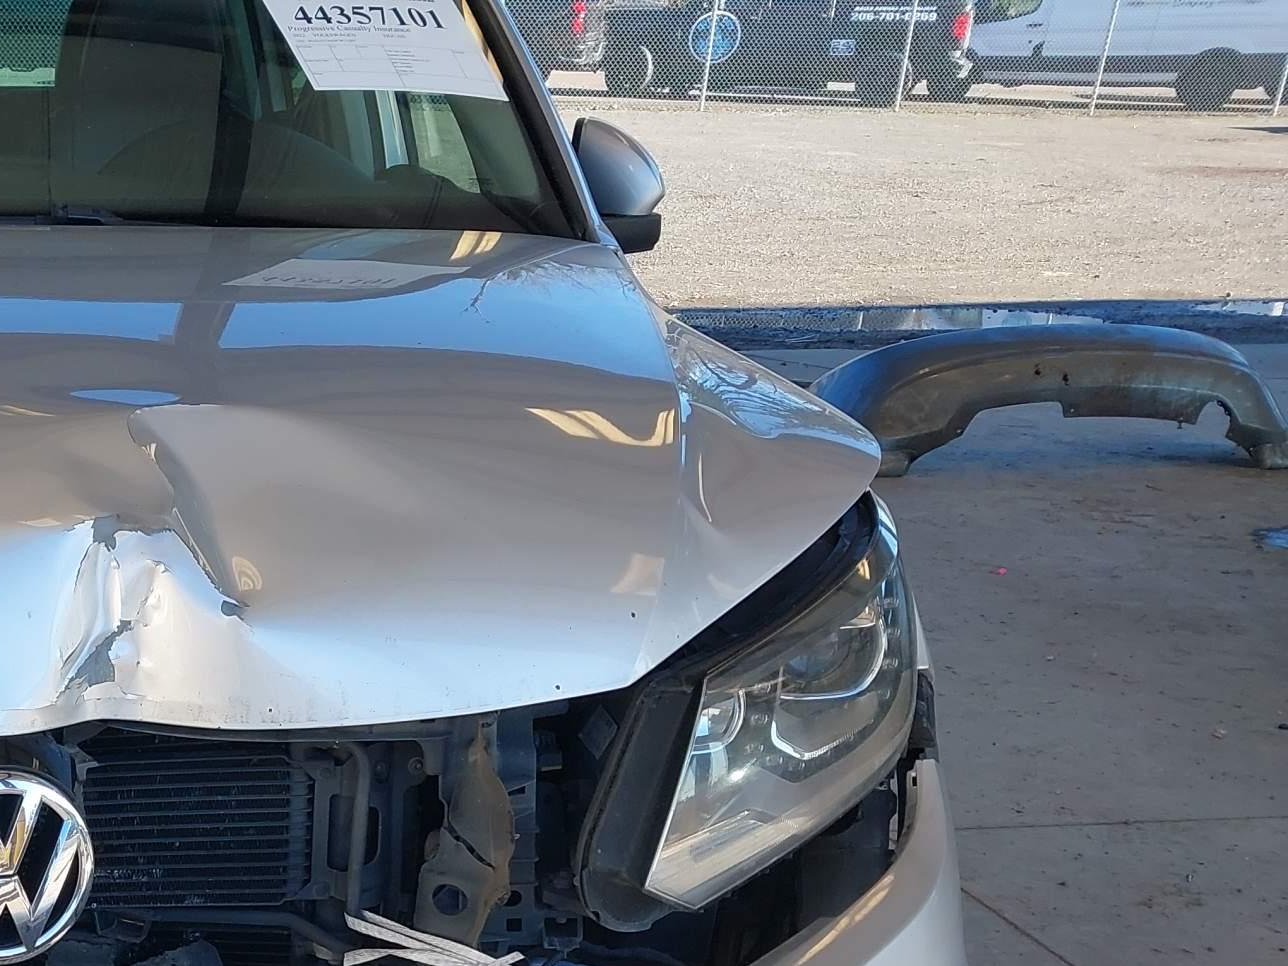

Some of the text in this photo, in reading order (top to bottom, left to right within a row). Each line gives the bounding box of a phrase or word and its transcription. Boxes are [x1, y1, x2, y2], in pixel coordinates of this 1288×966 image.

[294, 5, 447, 30] 44357101
[287, 25, 412, 33] Progressive Casualty Insurance
